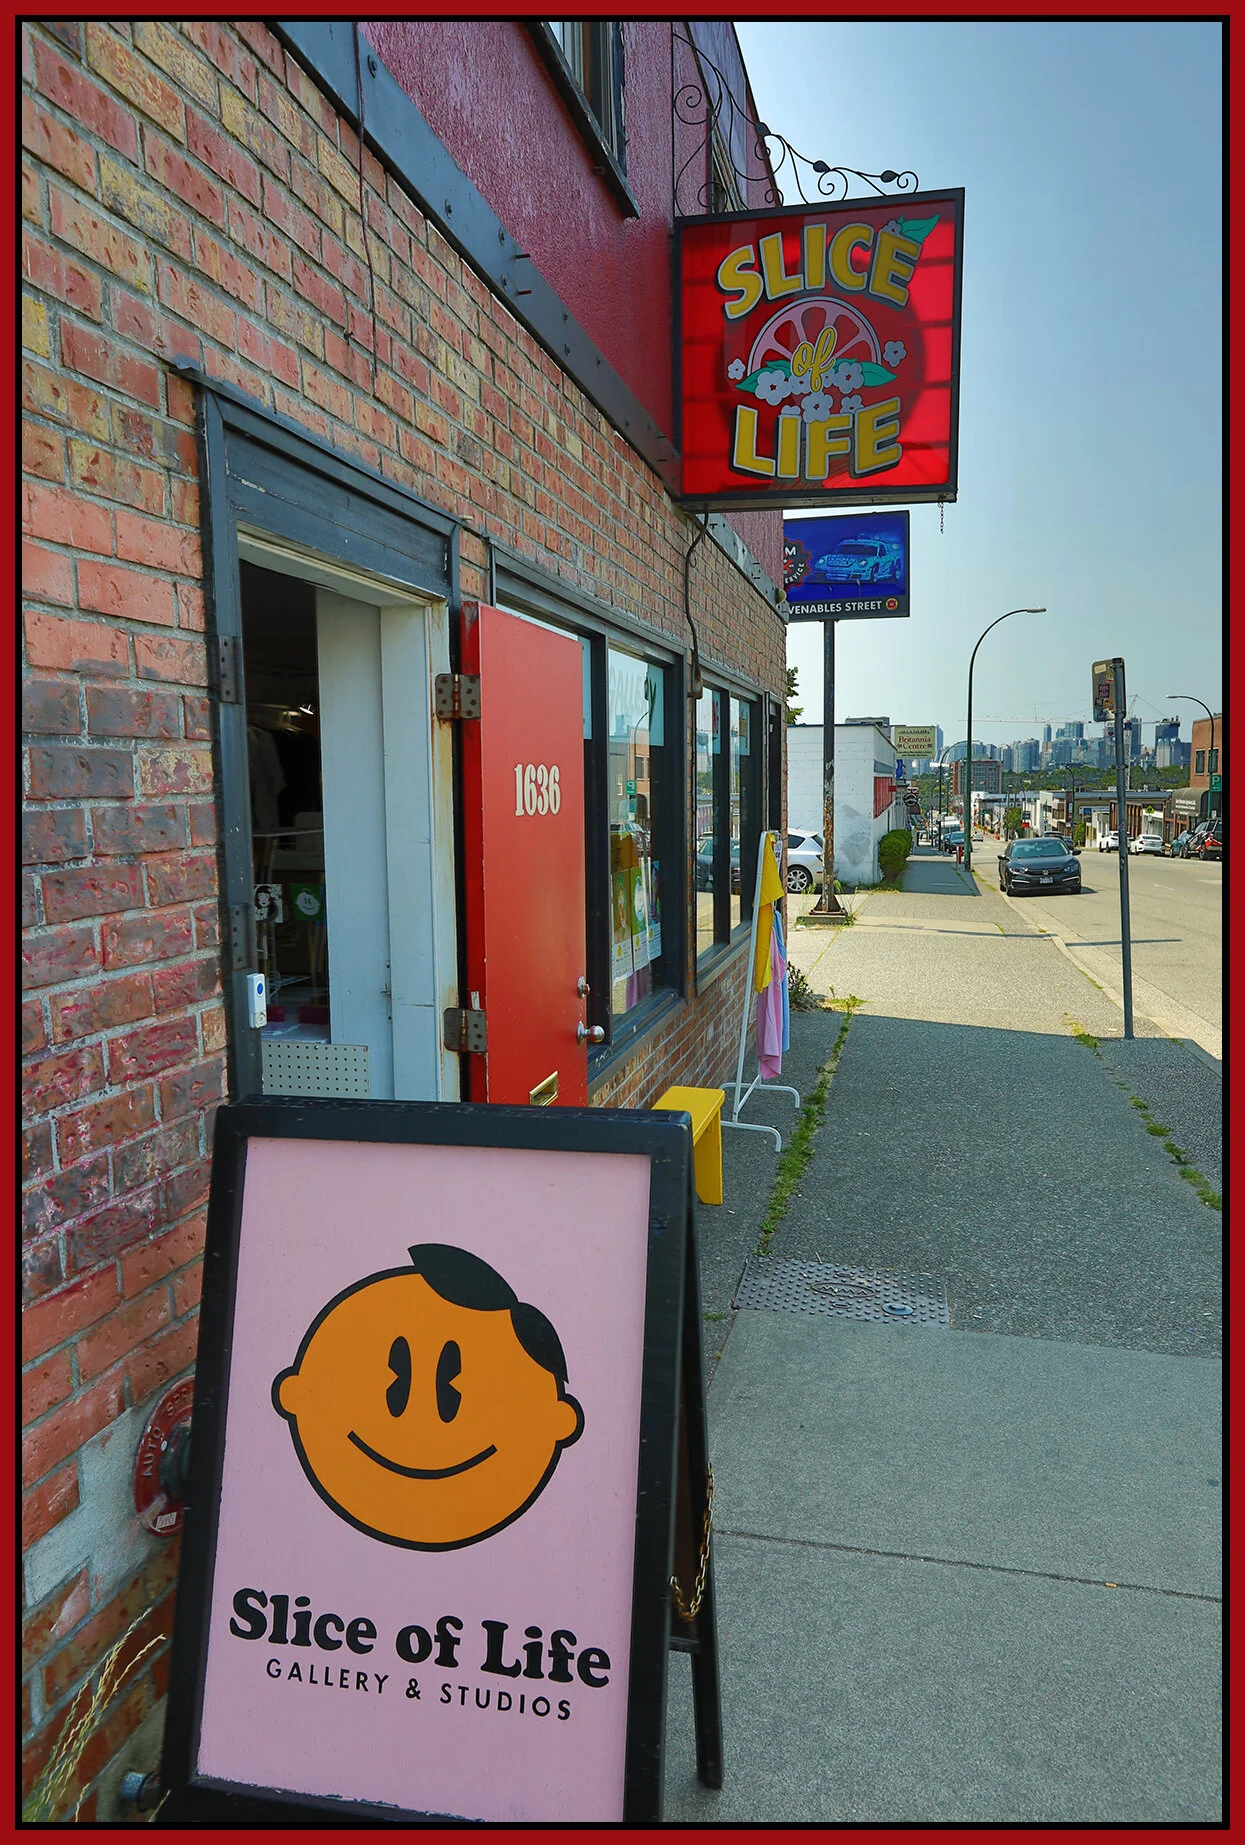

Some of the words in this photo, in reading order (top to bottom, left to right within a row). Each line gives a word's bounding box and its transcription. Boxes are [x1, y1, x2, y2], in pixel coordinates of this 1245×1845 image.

[716, 222, 923, 320] SLICE
[790, 326, 836, 392] of
[732, 397, 903, 481] LIFE
[788, 603, 842, 614] VENABLES
[844, 601, 882, 612] STREET
[514, 763, 561, 817] 1636
[1212, 776, 1220, 785] P
[142, 1427, 162, 1477] AUTO
[229, 1587, 378, 1655] Slice
[395, 1615, 464, 1668] of
[480, 1619, 612, 1689] Life
[265, 1658, 390, 1695] GALLERY
[405, 1678, 422, 1700] &
[439, 1682, 572, 1721] STUDIOS
